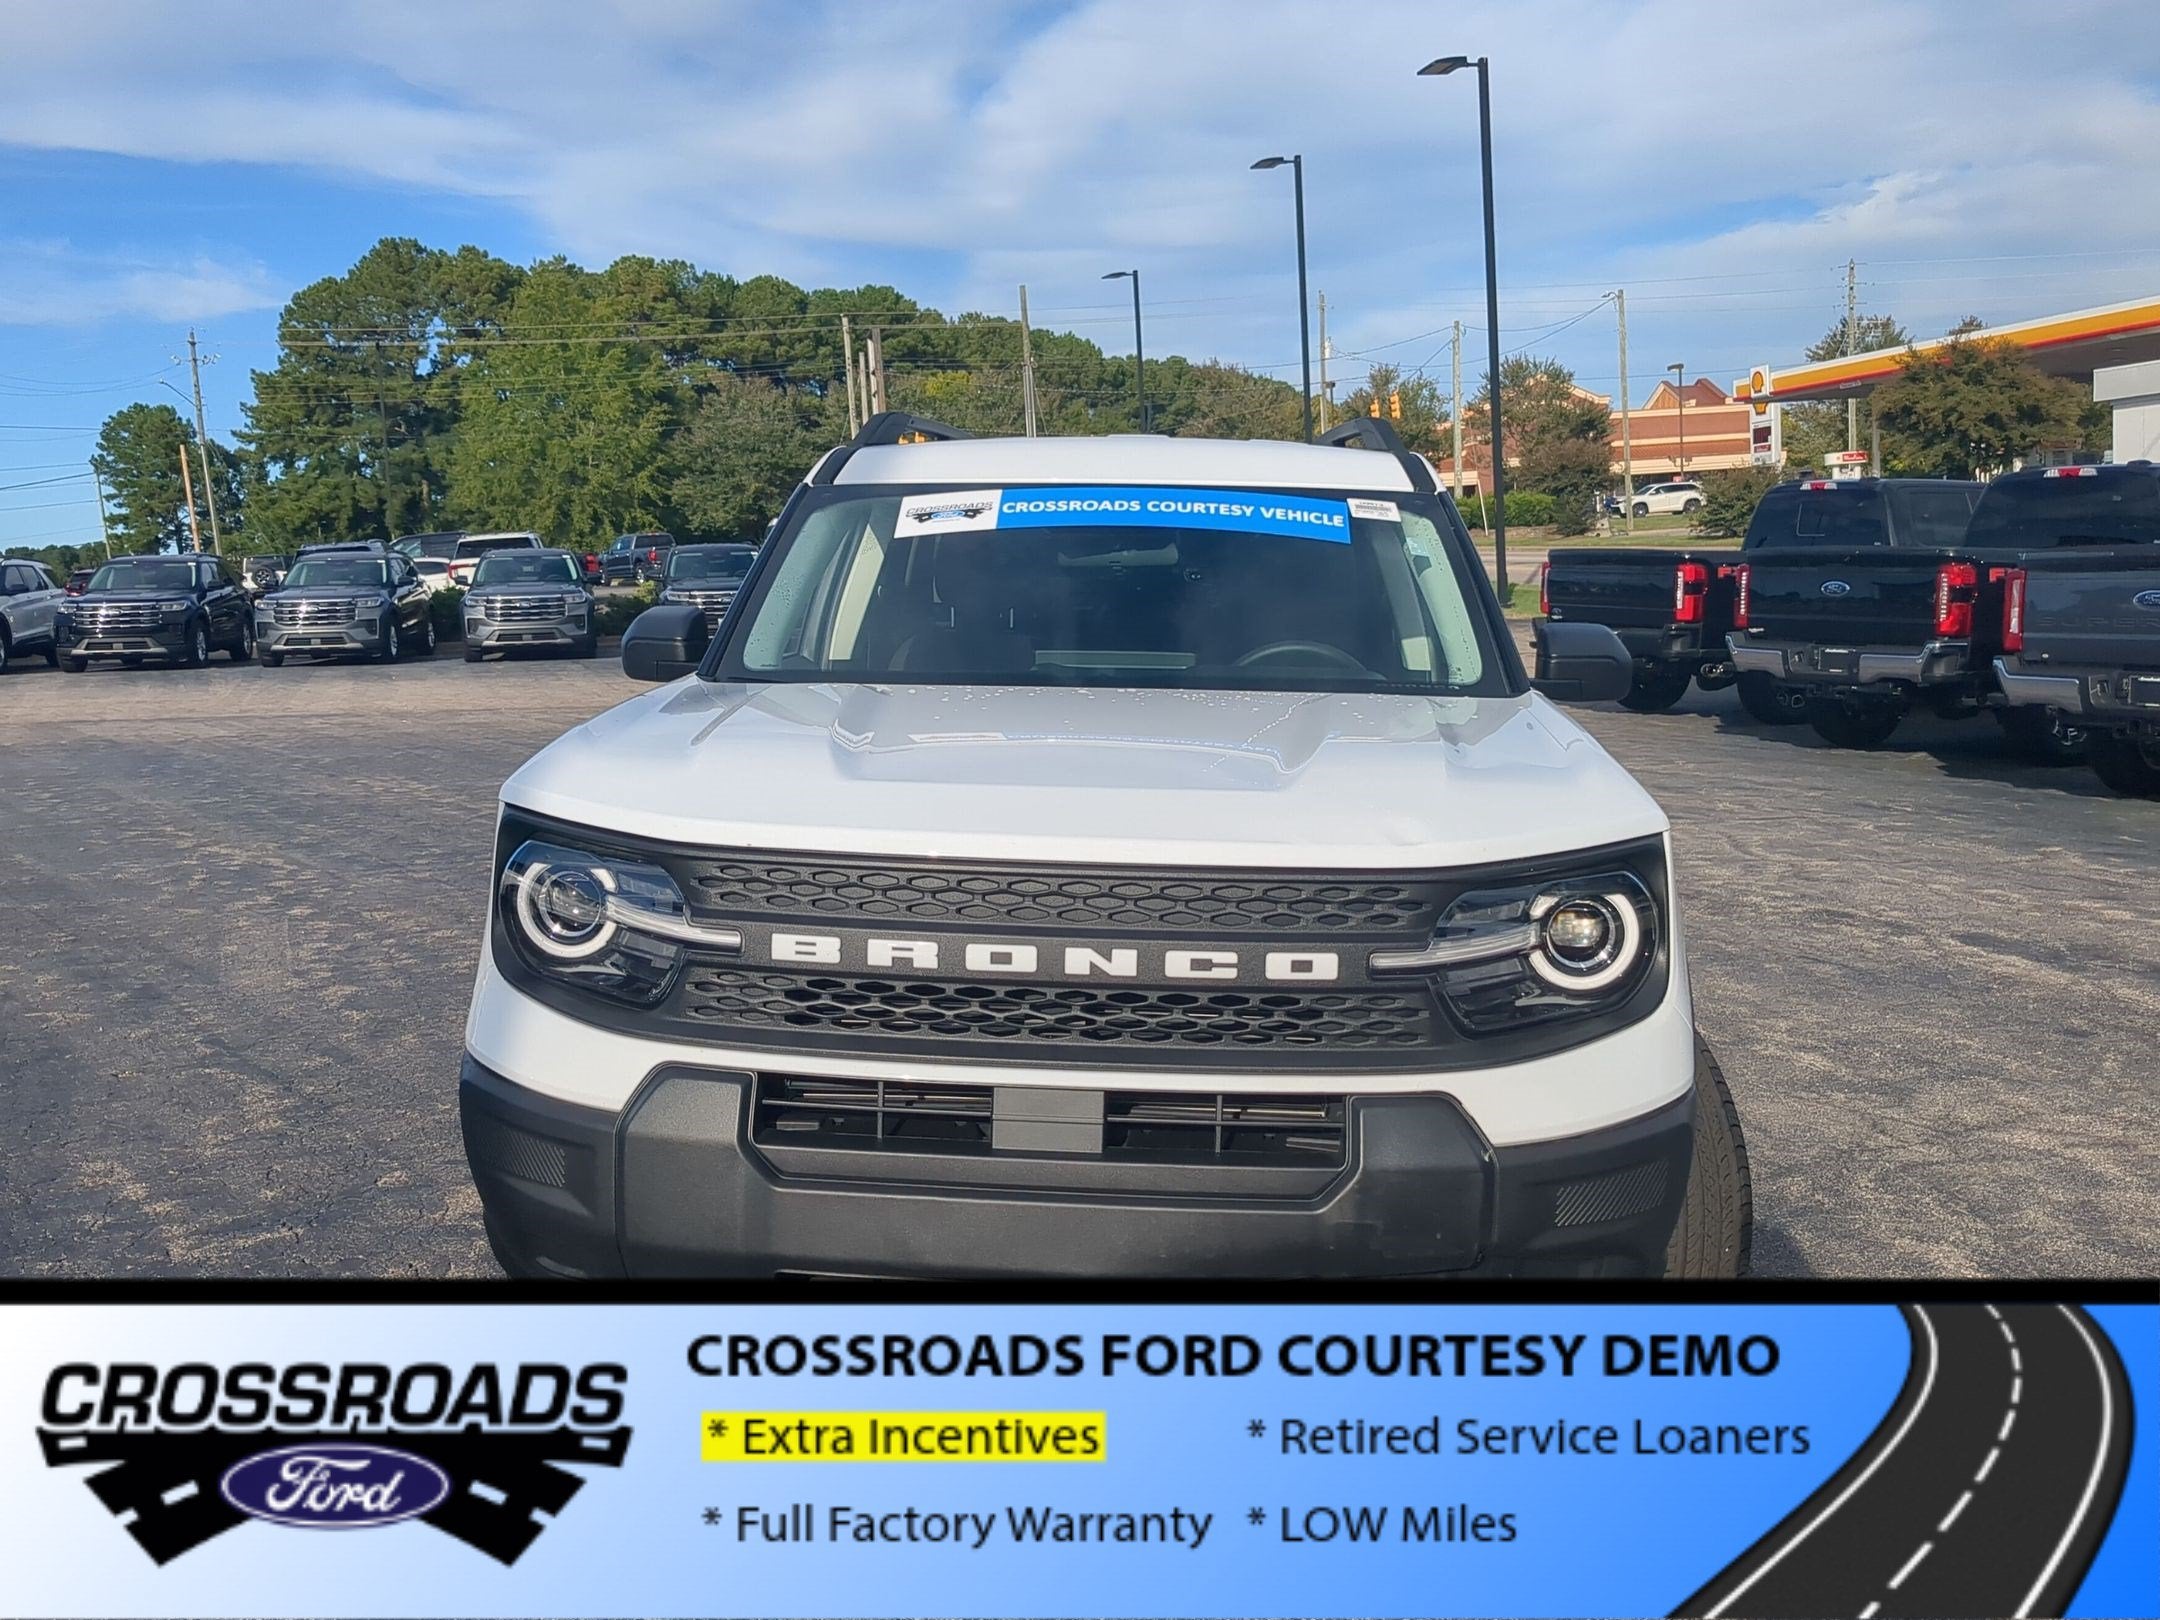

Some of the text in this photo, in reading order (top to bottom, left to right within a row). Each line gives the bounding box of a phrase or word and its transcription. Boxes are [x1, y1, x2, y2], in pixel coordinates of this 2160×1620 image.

[907, 501, 994, 515] CROSSROADS
[1002, 500, 1344, 527] CROSSROADS COURTESY VEHICLE
[771, 933, 1339, 981] BRONCO
